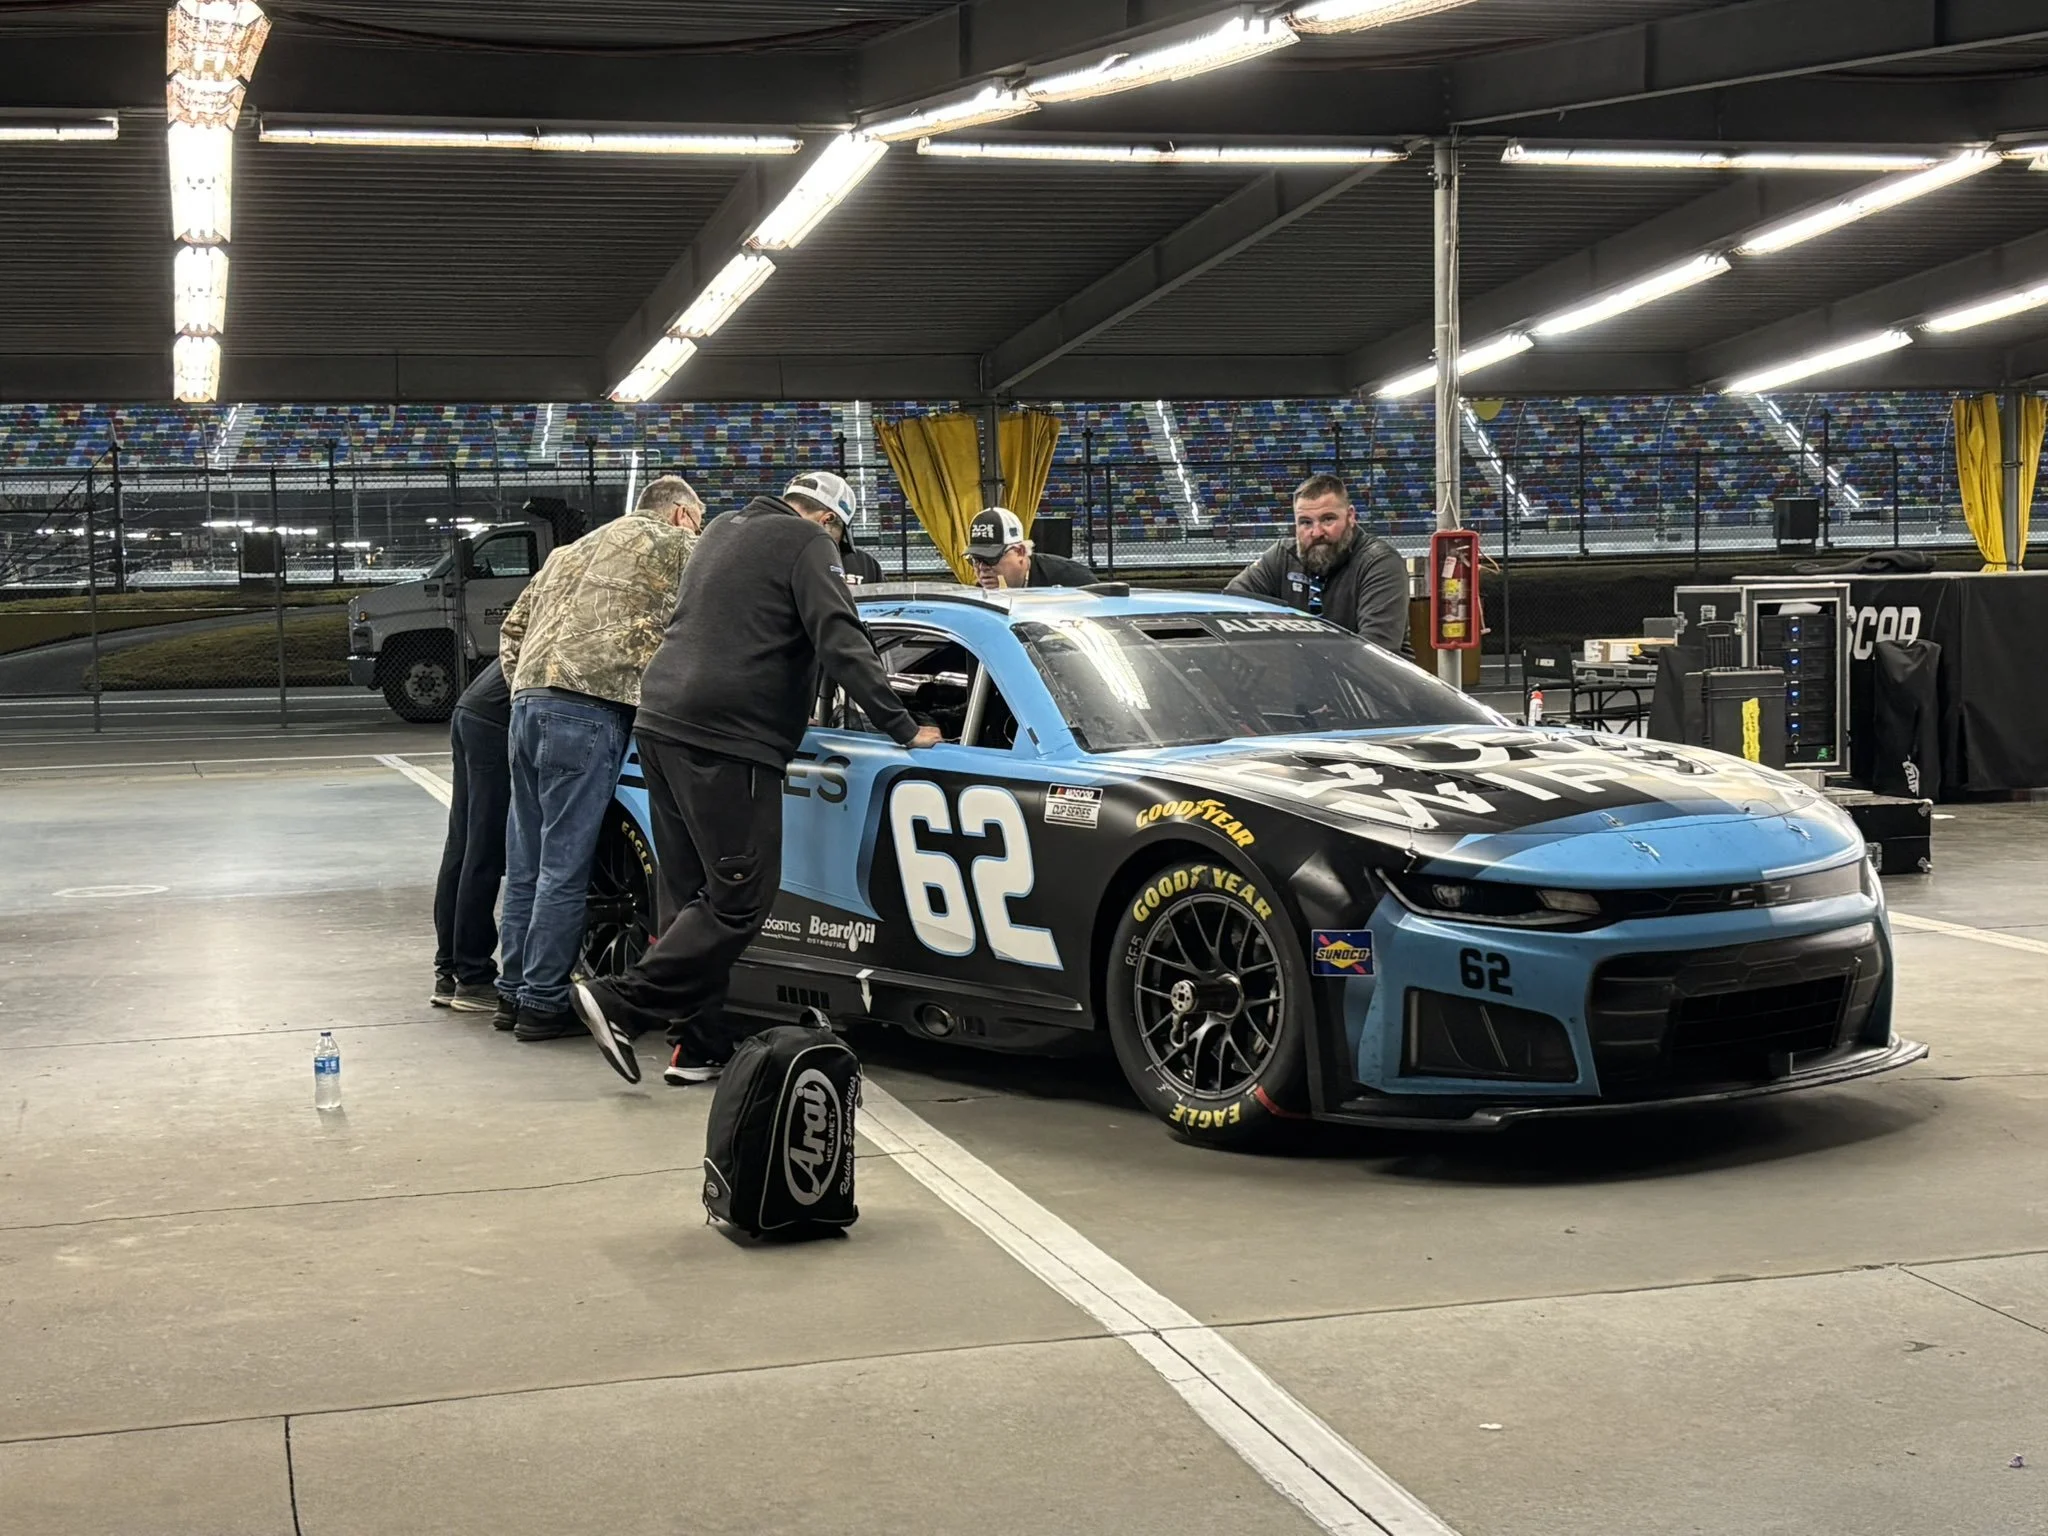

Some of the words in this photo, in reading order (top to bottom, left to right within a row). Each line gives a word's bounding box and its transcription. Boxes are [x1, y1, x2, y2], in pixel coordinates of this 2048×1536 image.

[1216, 619, 1340, 633] ALFREDO
[1052, 804, 1067, 815] CUP
[1066, 806, 1092, 819] SERIES
[1135, 799, 1255, 848] GOODYEAR
[621, 820, 653, 876] EAGLE
[889, 779, 1065, 972] 62
[1132, 865, 1273, 922] GOODYEAR
[1317, 949, 1369, 961] SUNOCO
[1459, 947, 1514, 996] 62
[790, 1084, 827, 1196] Arai
[826, 1109, 837, 1162] HELMET
[1169, 1101, 1239, 1130] EAGLE
